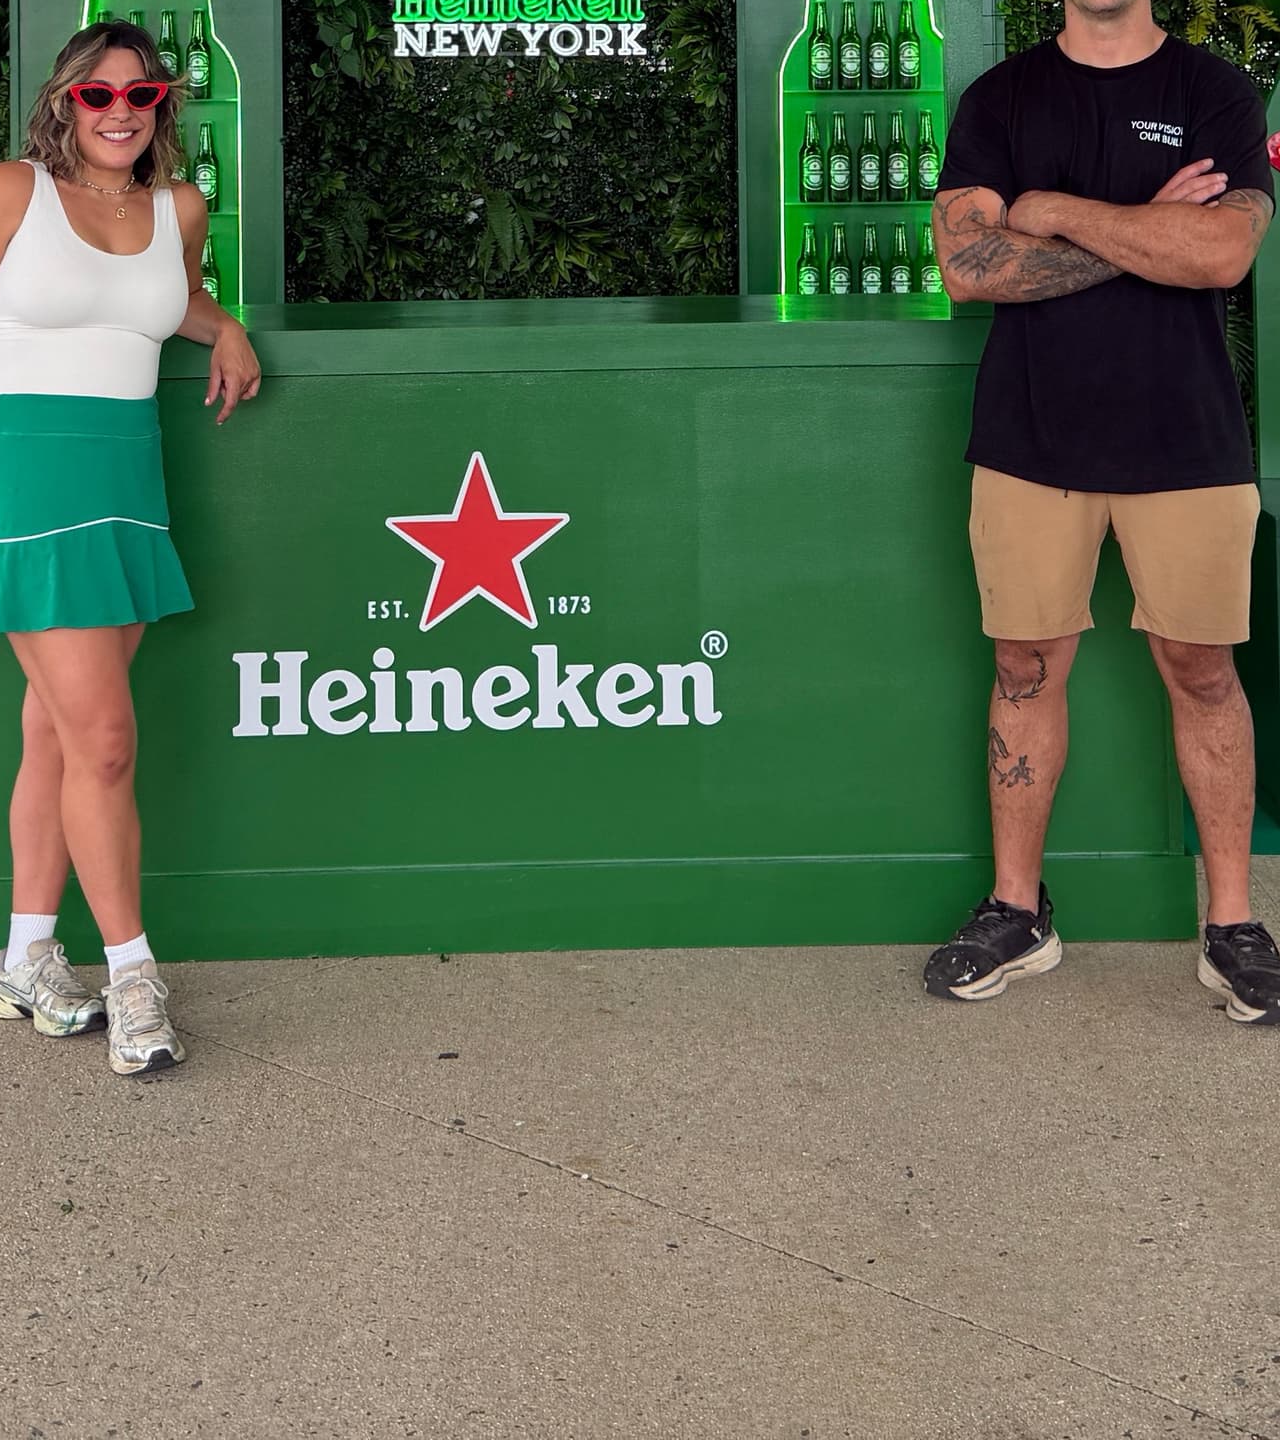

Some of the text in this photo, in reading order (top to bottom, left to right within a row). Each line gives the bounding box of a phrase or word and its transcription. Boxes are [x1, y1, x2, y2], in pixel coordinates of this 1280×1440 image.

[393, 22, 648, 57] NEW YORK
[1131, 120, 1158, 131] YOUR
[1139, 131, 1161, 142] OUR
[367, 595, 592, 620] EST. 1873
